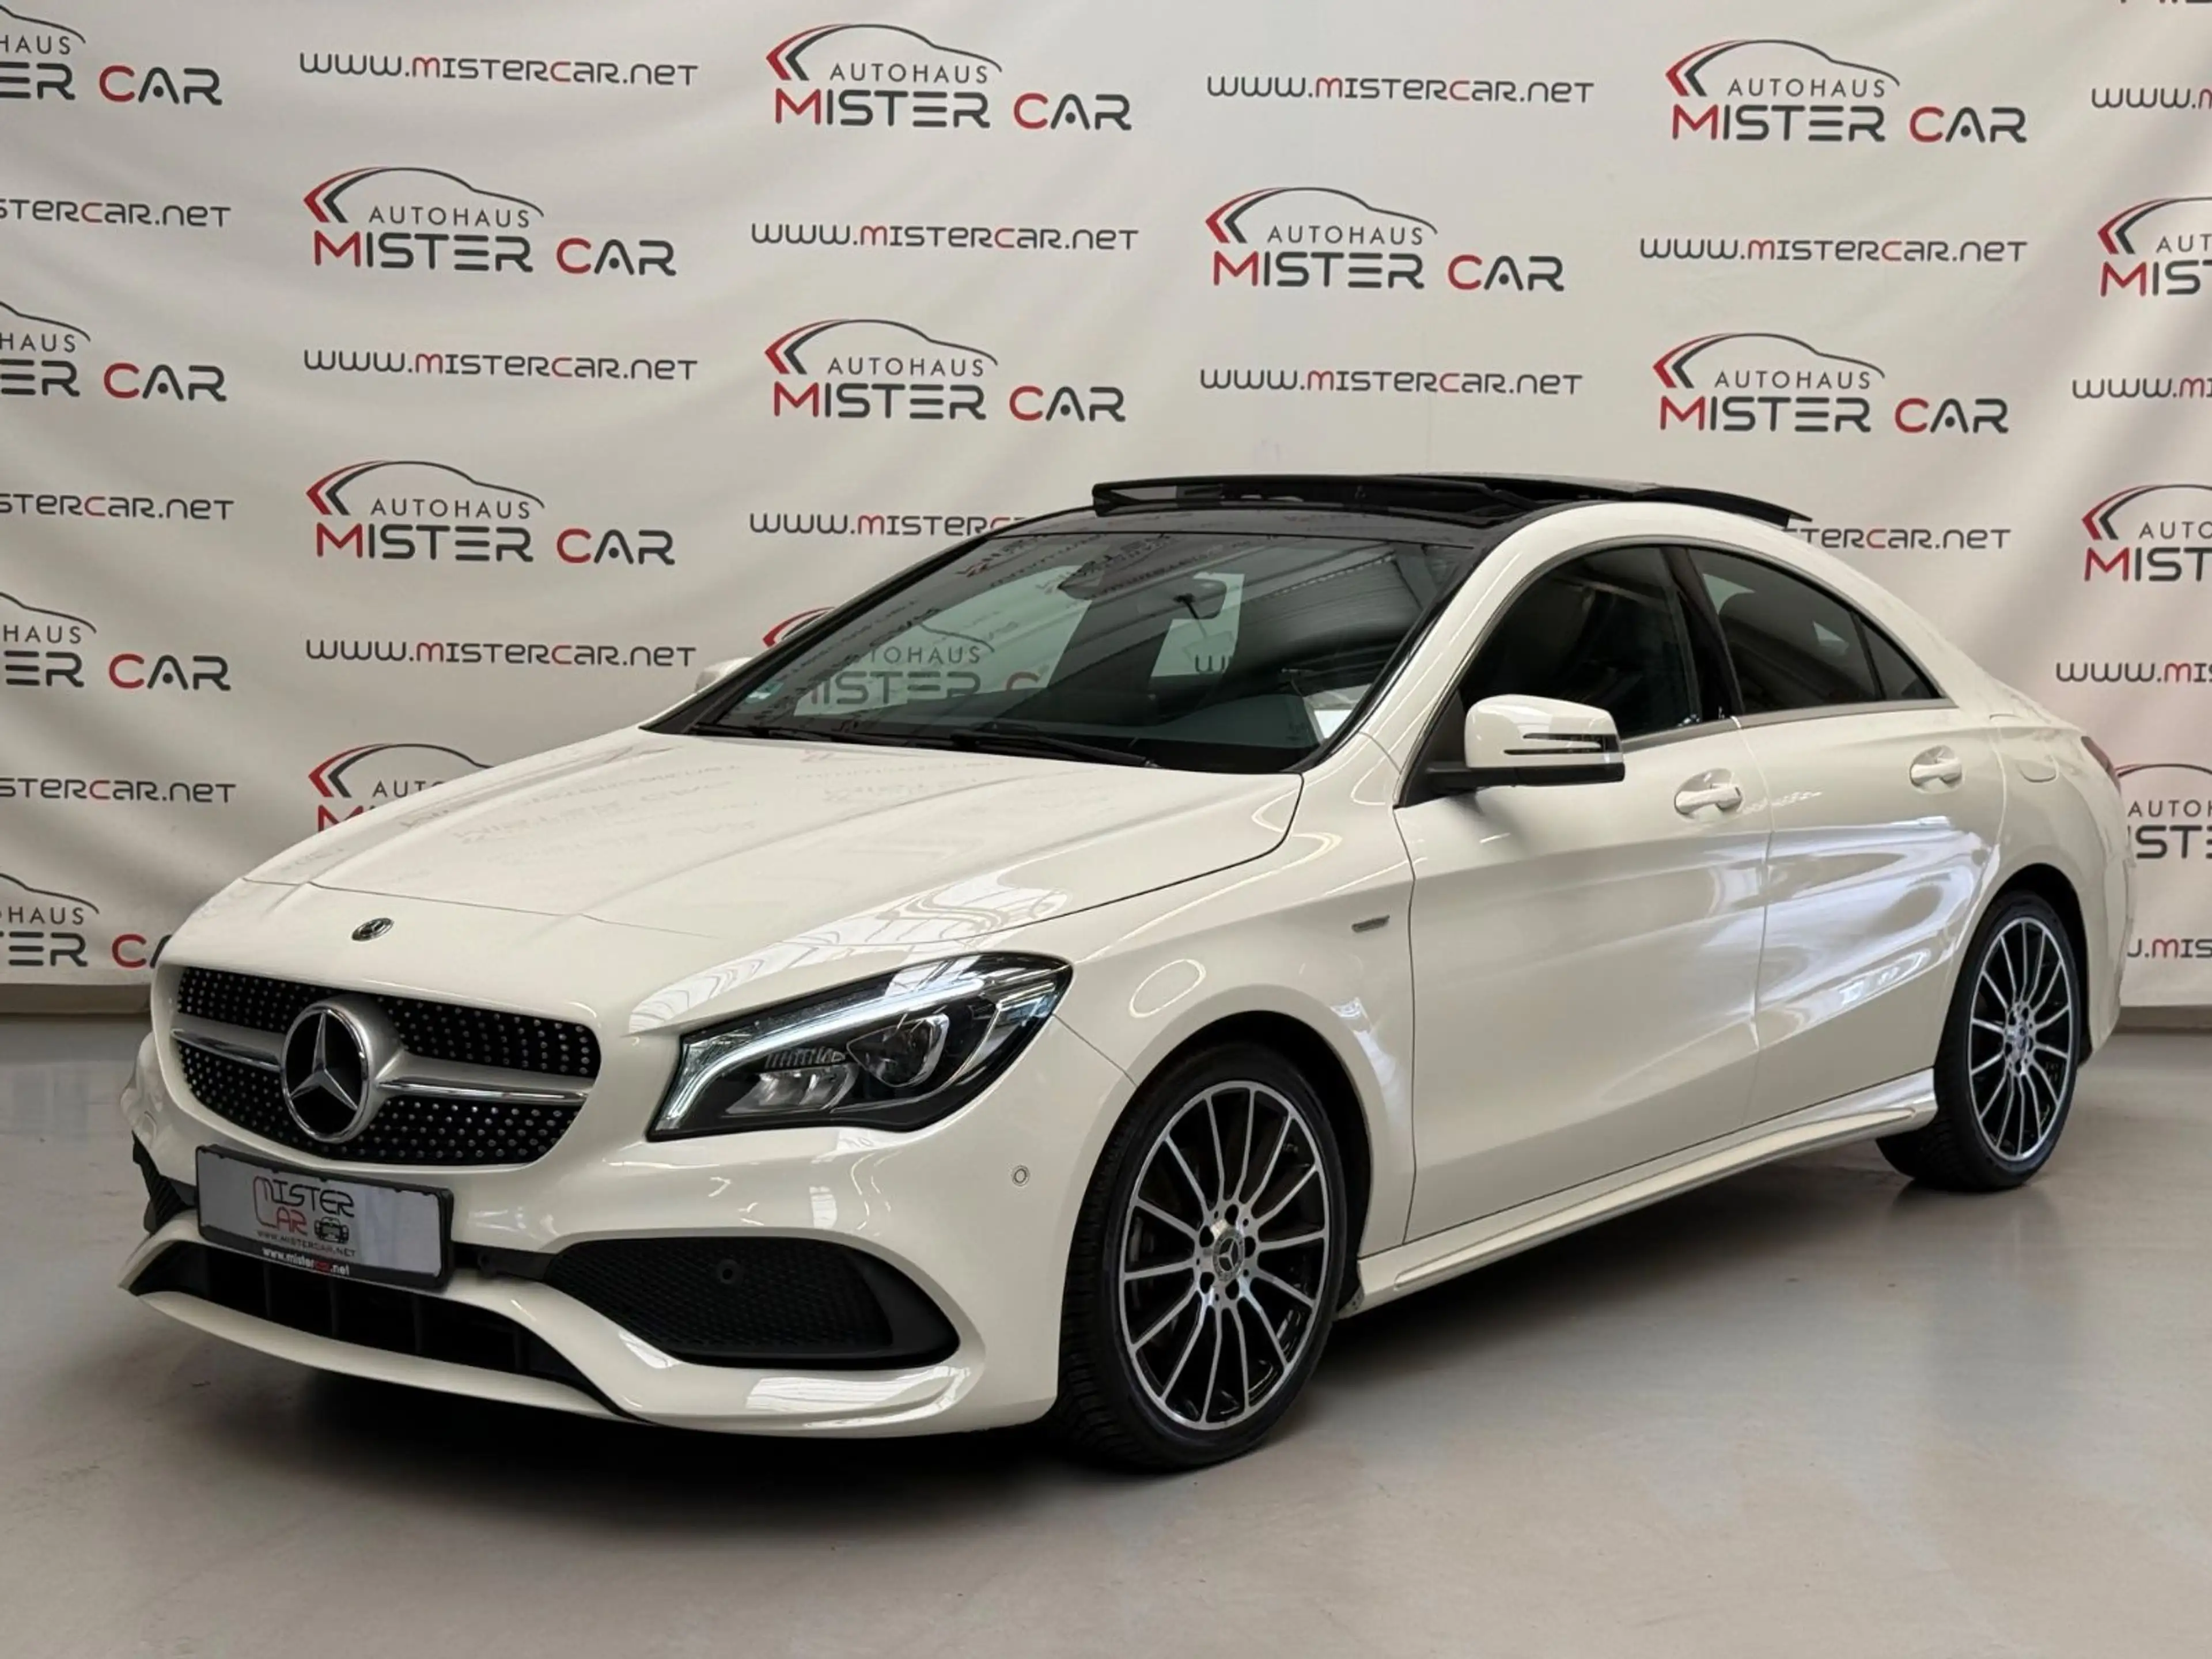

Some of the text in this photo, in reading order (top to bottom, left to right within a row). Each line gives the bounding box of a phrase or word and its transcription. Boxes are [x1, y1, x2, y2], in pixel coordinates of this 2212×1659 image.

[99, 65, 222, 106] CAR
[829, 62, 988, 84] AUTOHAUS
[1727, 78, 1885, 98] AUTOHAUS
[775, 88, 1132, 131] MISTER CAR
[1672, 104, 2027, 143] MISTER CAR
[369, 206, 529, 228] AUTOHAUS
[1267, 224, 1423, 246] AUTOHAUS
[314, 230, 677, 276] MISTER CAR
[1213, 251, 1565, 292] MISTER CAR
[104, 362, 227, 402] CAR
[827, 357, 984, 377] AUTOHAUS
[1714, 370, 1870, 390] AUTOHAUS
[774, 381, 1126, 423] MISTER CAR
[1660, 396, 2009, 434] MISTER CAR
[370, 498, 531, 520] AUTOHAUS
[316, 522, 676, 566] MISTER CAR
[109, 653, 231, 691] CAR
[0, 906, 84, 926] HAUS
[253, 1175, 355, 1218] MISTER
